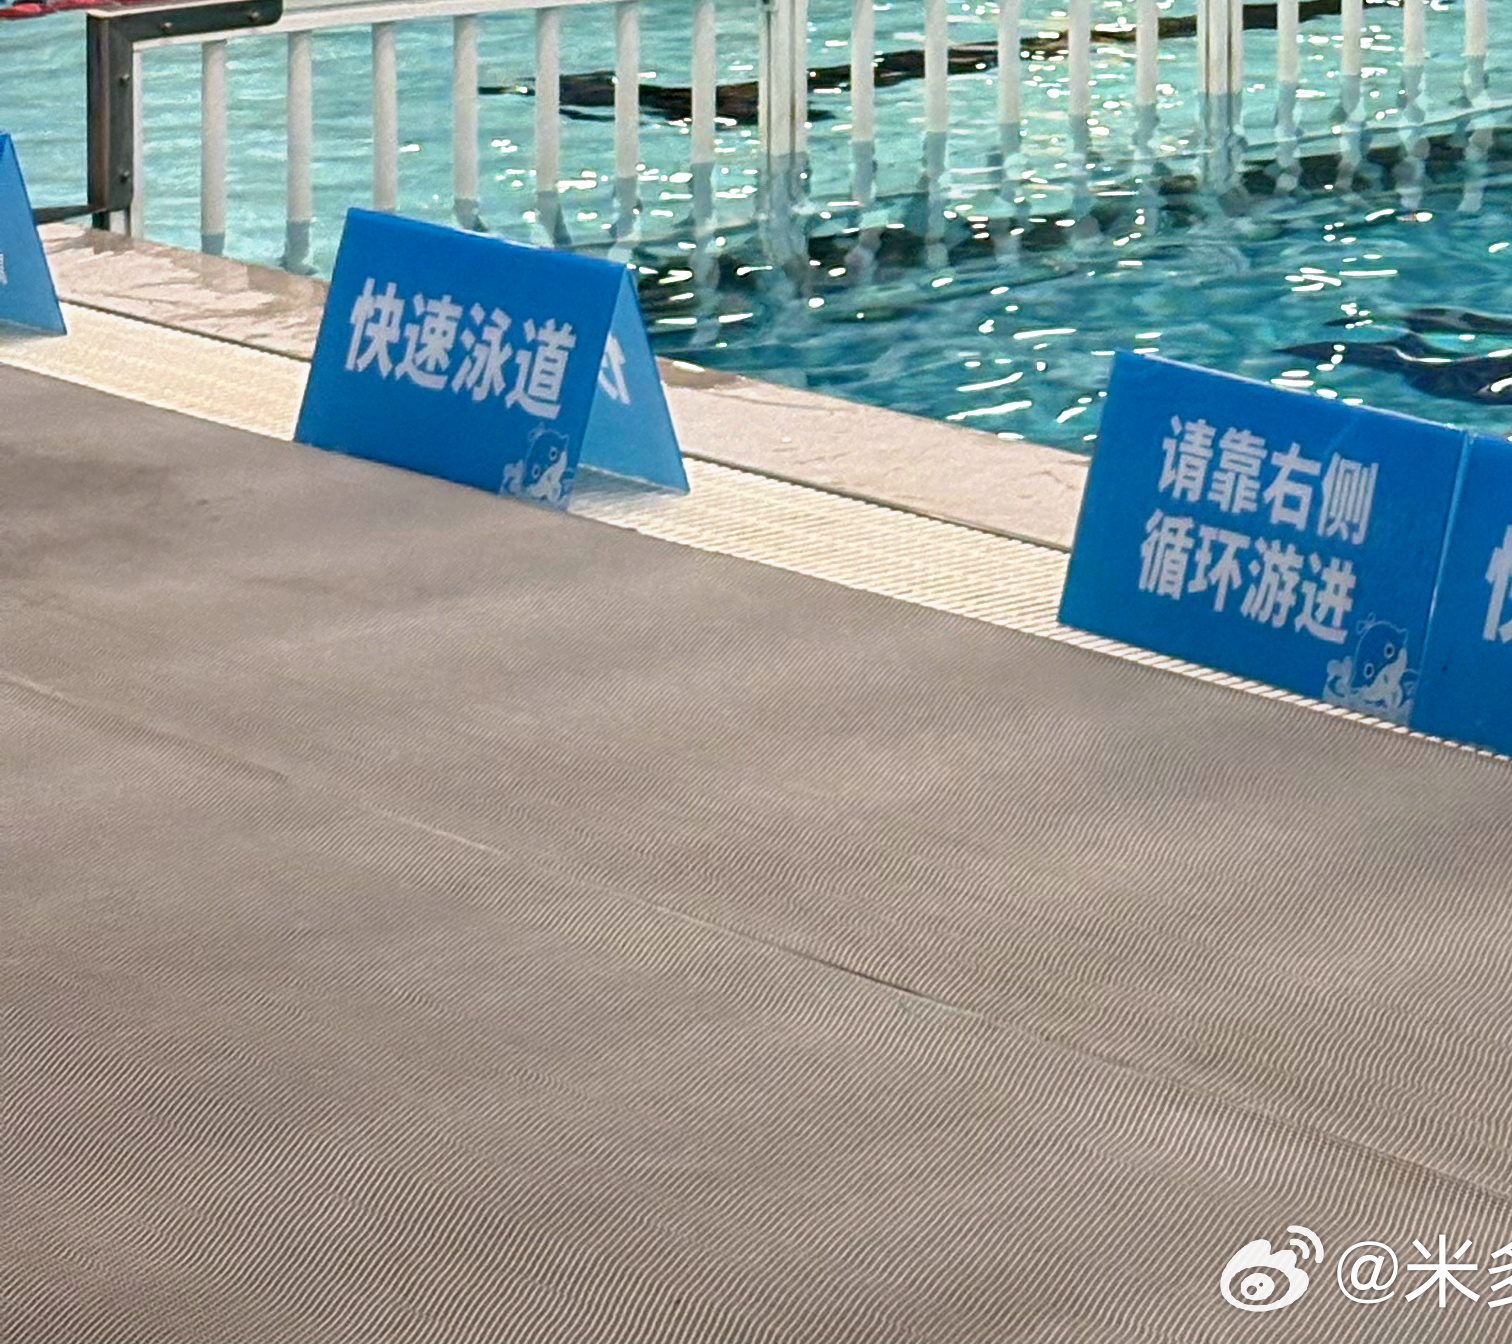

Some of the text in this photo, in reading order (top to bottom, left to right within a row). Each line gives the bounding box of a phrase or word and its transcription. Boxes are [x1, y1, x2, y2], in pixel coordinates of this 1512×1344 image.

[345, 277, 576, 420] 快速泳道
[1157, 415, 1379, 545] 请靠右侧
[1138, 509, 1358, 645] 循环游进
